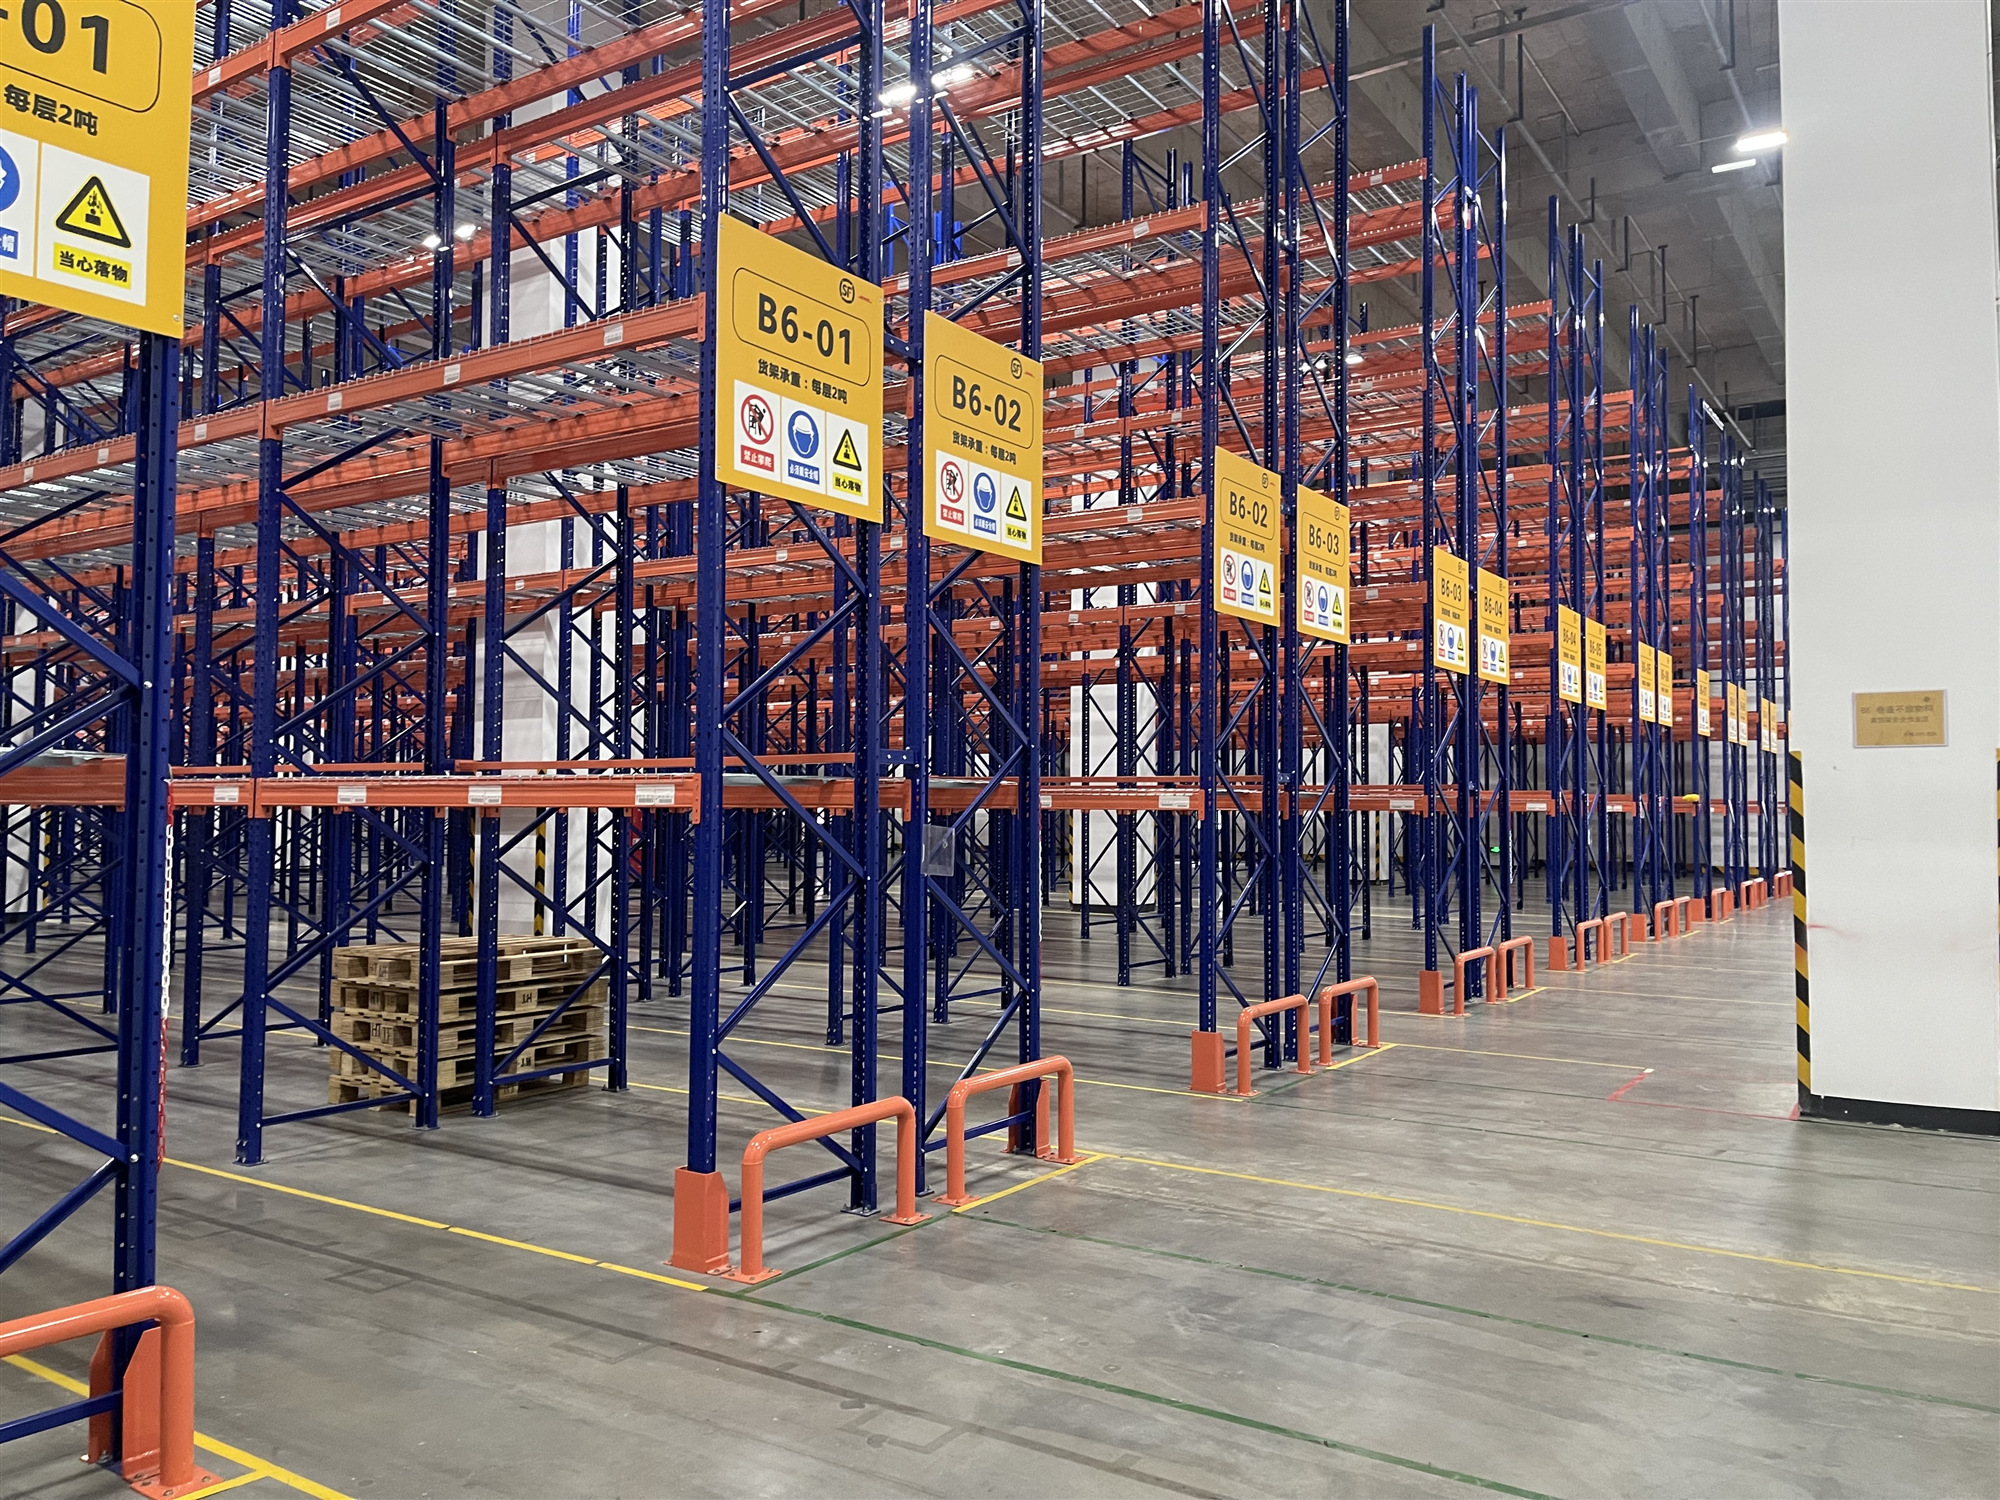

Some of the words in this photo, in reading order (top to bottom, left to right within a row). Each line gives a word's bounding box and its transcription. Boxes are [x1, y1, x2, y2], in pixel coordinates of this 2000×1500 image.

[4, 84, 98, 137] 每层2吨
[59, 250, 128, 283] 当心落物
[758, 292, 851, 365] B6-01
[758, 358, 848, 405] 货架承重：每层2吨
[952, 375, 1021, 433] B6-02
[1229, 491, 1268, 529] B6-02
[1308, 523, 1340, 556] B6-03
[1441, 577, 1462, 602] B6-03
[1484, 596, 1503, 618] B6-04
